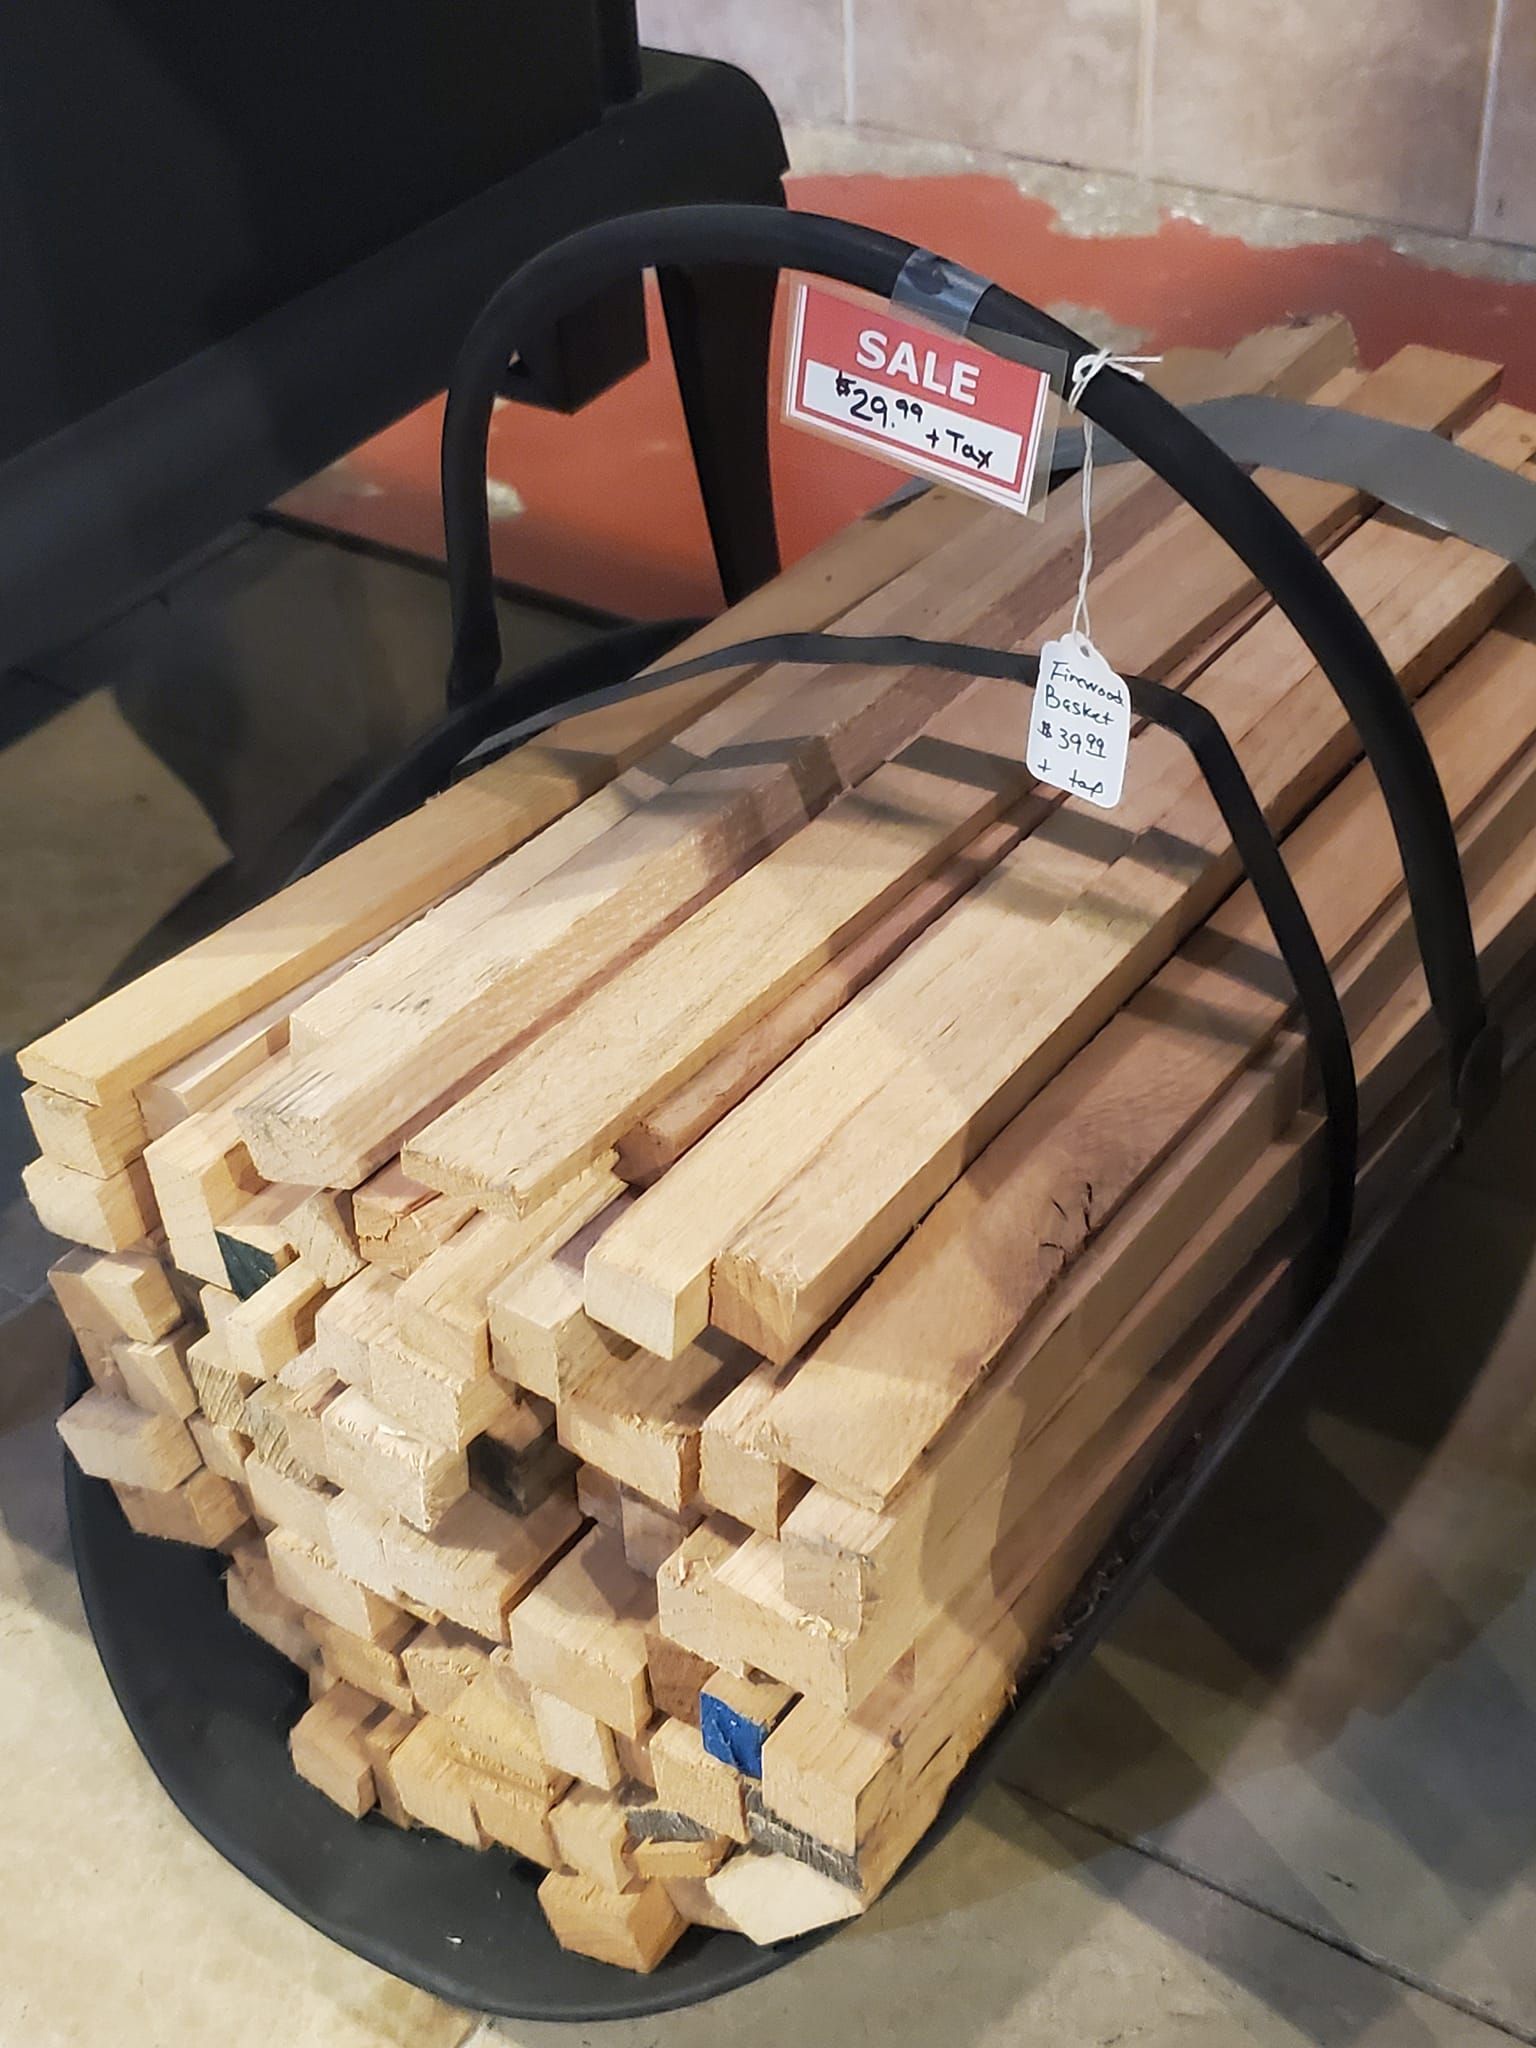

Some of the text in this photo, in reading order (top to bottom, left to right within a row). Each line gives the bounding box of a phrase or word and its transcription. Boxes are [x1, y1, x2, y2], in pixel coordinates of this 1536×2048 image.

[855, 329, 980, 406] SALE
[1045, 684, 1114, 726] Basket
[1050, 660, 1125, 706] Firewood
